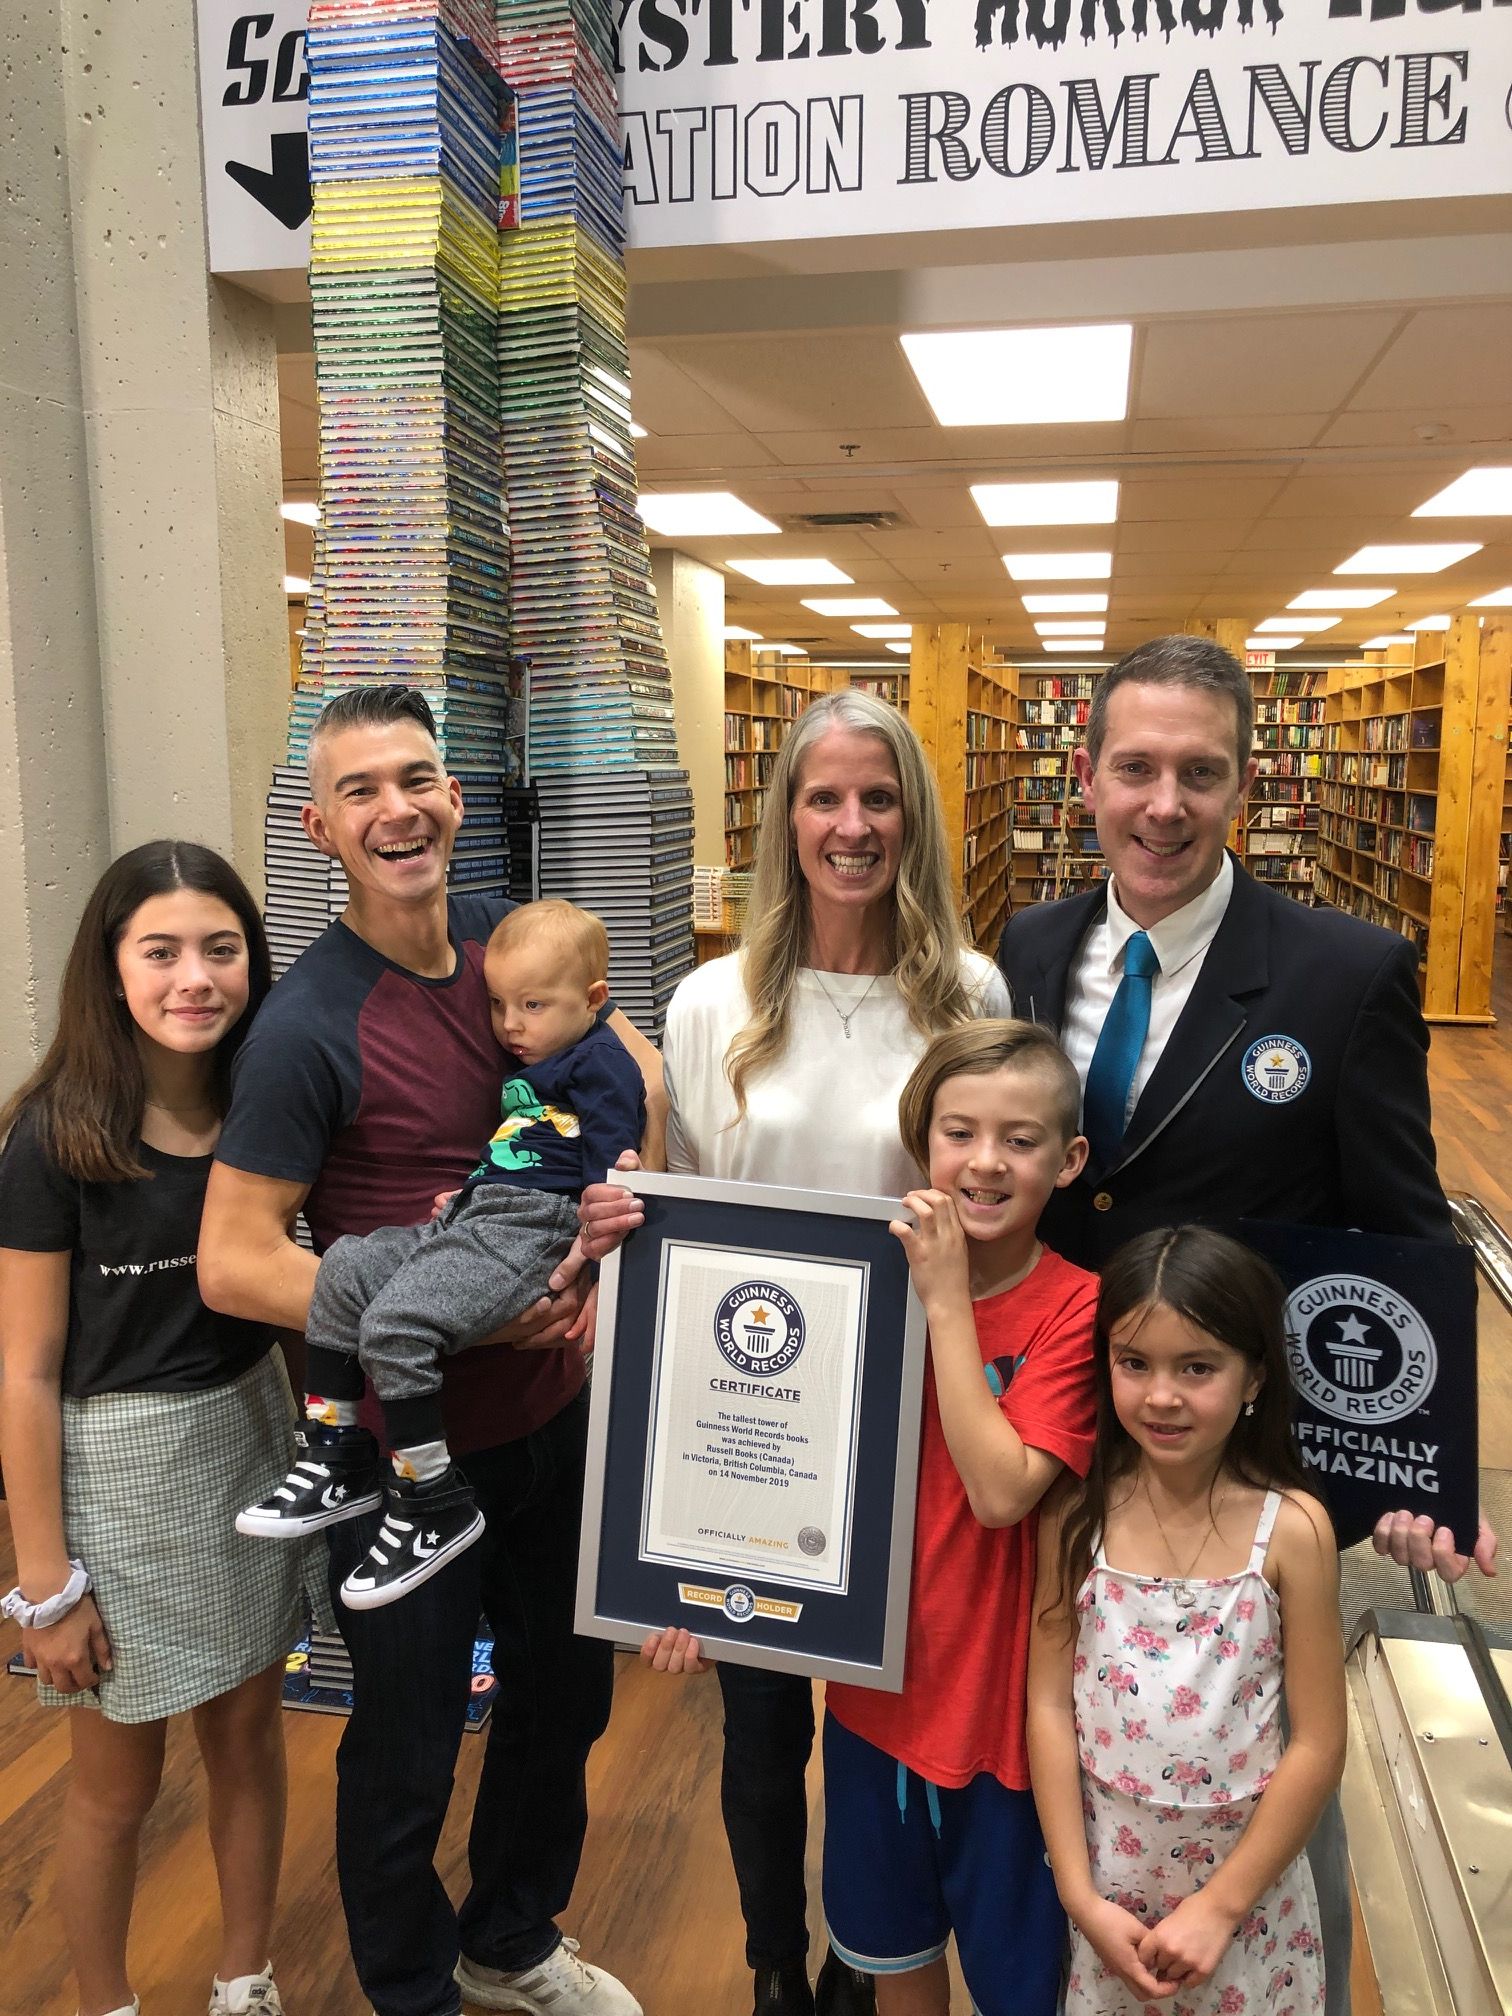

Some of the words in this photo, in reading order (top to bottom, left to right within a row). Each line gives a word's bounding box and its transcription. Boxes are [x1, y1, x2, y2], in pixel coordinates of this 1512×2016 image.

[617, 94, 863, 205] ATION
[897, 50, 1469, 184] ROMANCE
[1252, 1039, 1303, 1059] GUINNESS
[1246, 1064, 1268, 1096] WORLD
[1271, 1066, 1307, 1100] RECORDS
[729, 1286, 795, 1315] GUINNESS
[1297, 1284, 1412, 1329] GUINNESS
[719, 1318, 747, 1366] WORLD
[750, 1327, 800, 1371] RECORDS
[1285, 1332, 1337, 1403] WORLD
[1346, 1350, 1426, 1414] RECORDS
[709, 1379, 801, 1402] CERTIFICATE
[696, 1420, 730, 1432] Guinness
[731, 1425, 753, 1435] World
[754, 1429, 785, 1441] Records
[786, 1433, 809, 1444] books
[718, 1411, 731, 1420] The
[732, 1414, 756, 1424] tallest
[758, 1418, 778, 1427] tower
[780, 1421, 789, 1429] of
[707, 1444, 734, 1456] Russell
[735, 1449, 758, 1459] Books
[759, 1453, 795, 1466] (Canada)
[722, 1436, 736, 1445] was
[738, 1439, 771, 1450] achieved
[772, 1443, 781, 1452] by
[1291, 1422, 1440, 1464] FFICIALLY
[691, 1453, 721, 1466] Victoria,
[723, 1459, 748, 1469] British
[749, 1462, 787, 1476] Columbia,
[788, 1468, 818, 1481] Canada
[720, 1469, 729, 1478] 14
[730, 1471, 768, 1484] November
[769, 1477, 790, 1487] 2019
[697, 1528, 747, 1542] OFFICIALLY
[748, 1536, 789, 1550] AMAZING
[687, 1590, 723, 1603] RECORD
[756, 1602, 793, 1615] HOLDER
